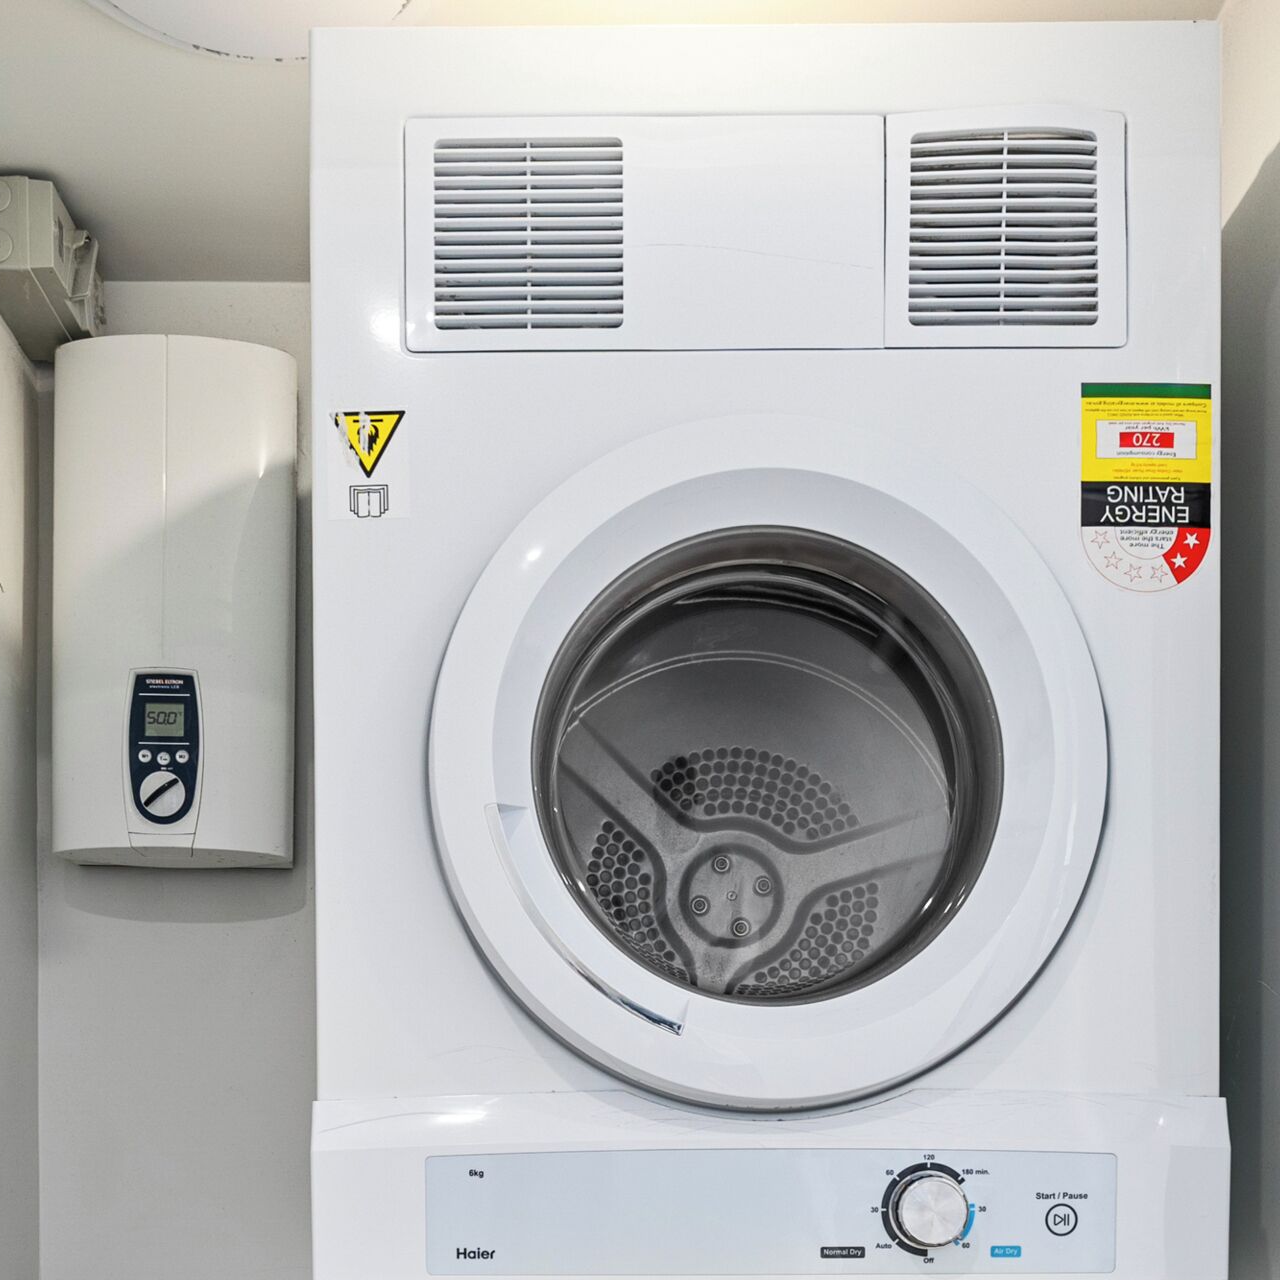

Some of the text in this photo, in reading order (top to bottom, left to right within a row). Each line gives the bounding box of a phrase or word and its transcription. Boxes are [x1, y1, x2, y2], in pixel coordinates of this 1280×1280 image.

[1133, 434, 1160, 446] 270
[1107, 486, 1184, 503] RATING
[1100, 506, 1189, 523] ENERGY
[147, 711, 177, 725] 50.0
[469, 1169, 484, 1179] 6kg
[1035, 1192, 1088, 1200] Start / Pause
[456, 1247, 496, 1259] Haier
[848, 1248, 862, 1256] Dry
[1005, 1248, 1018, 1256] Dry
